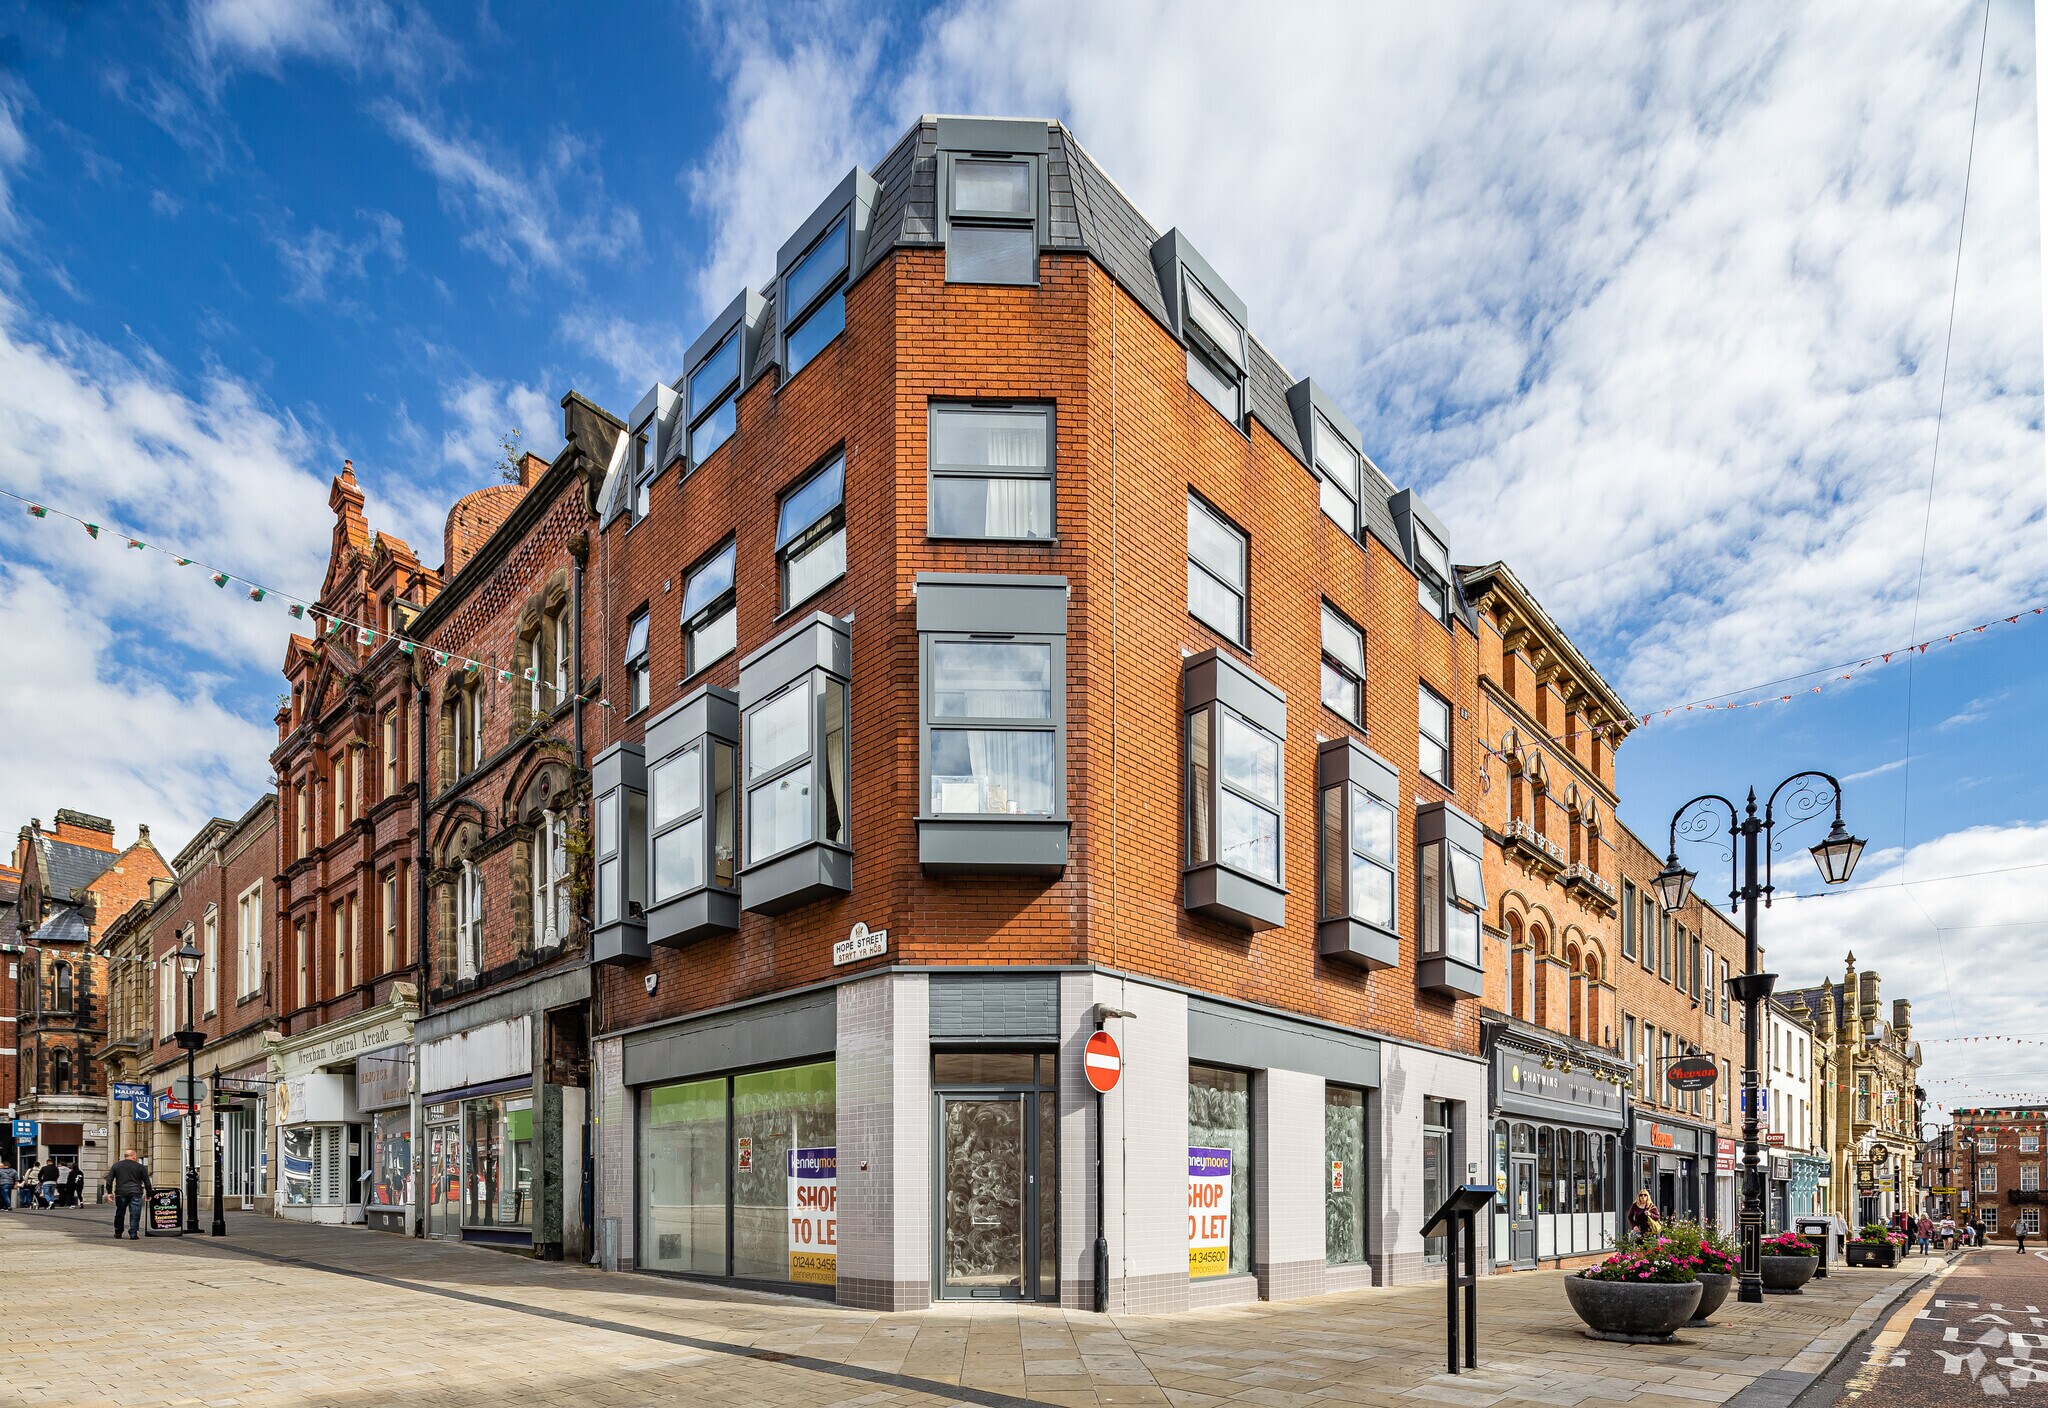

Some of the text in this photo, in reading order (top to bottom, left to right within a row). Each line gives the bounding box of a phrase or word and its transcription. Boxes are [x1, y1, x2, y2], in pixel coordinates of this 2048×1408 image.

[836, 933, 884, 954] HOPE STREET
[838, 951, 857, 962] STRYT
[859, 948, 868, 957] YR
[297, 1025, 390, 1065] Wrexham Central Arcade
[1522, 1070, 1559, 1089] CHATWINS
[1667, 1067, 1717, 1080] Chevron
[115, 1088, 145, 1096] HALIFAX
[135, 1101, 151, 1120] S
[1520, 1132, 1525, 1146] 3
[1651, 1122, 1674, 1149] Chevron
[792, 1218, 837, 1246] TO LE
[1201, 1215, 1227, 1239] LET
[792, 1256, 837, 1271] 01244 3456
[1198, 1250, 1226, 1264] 345600
